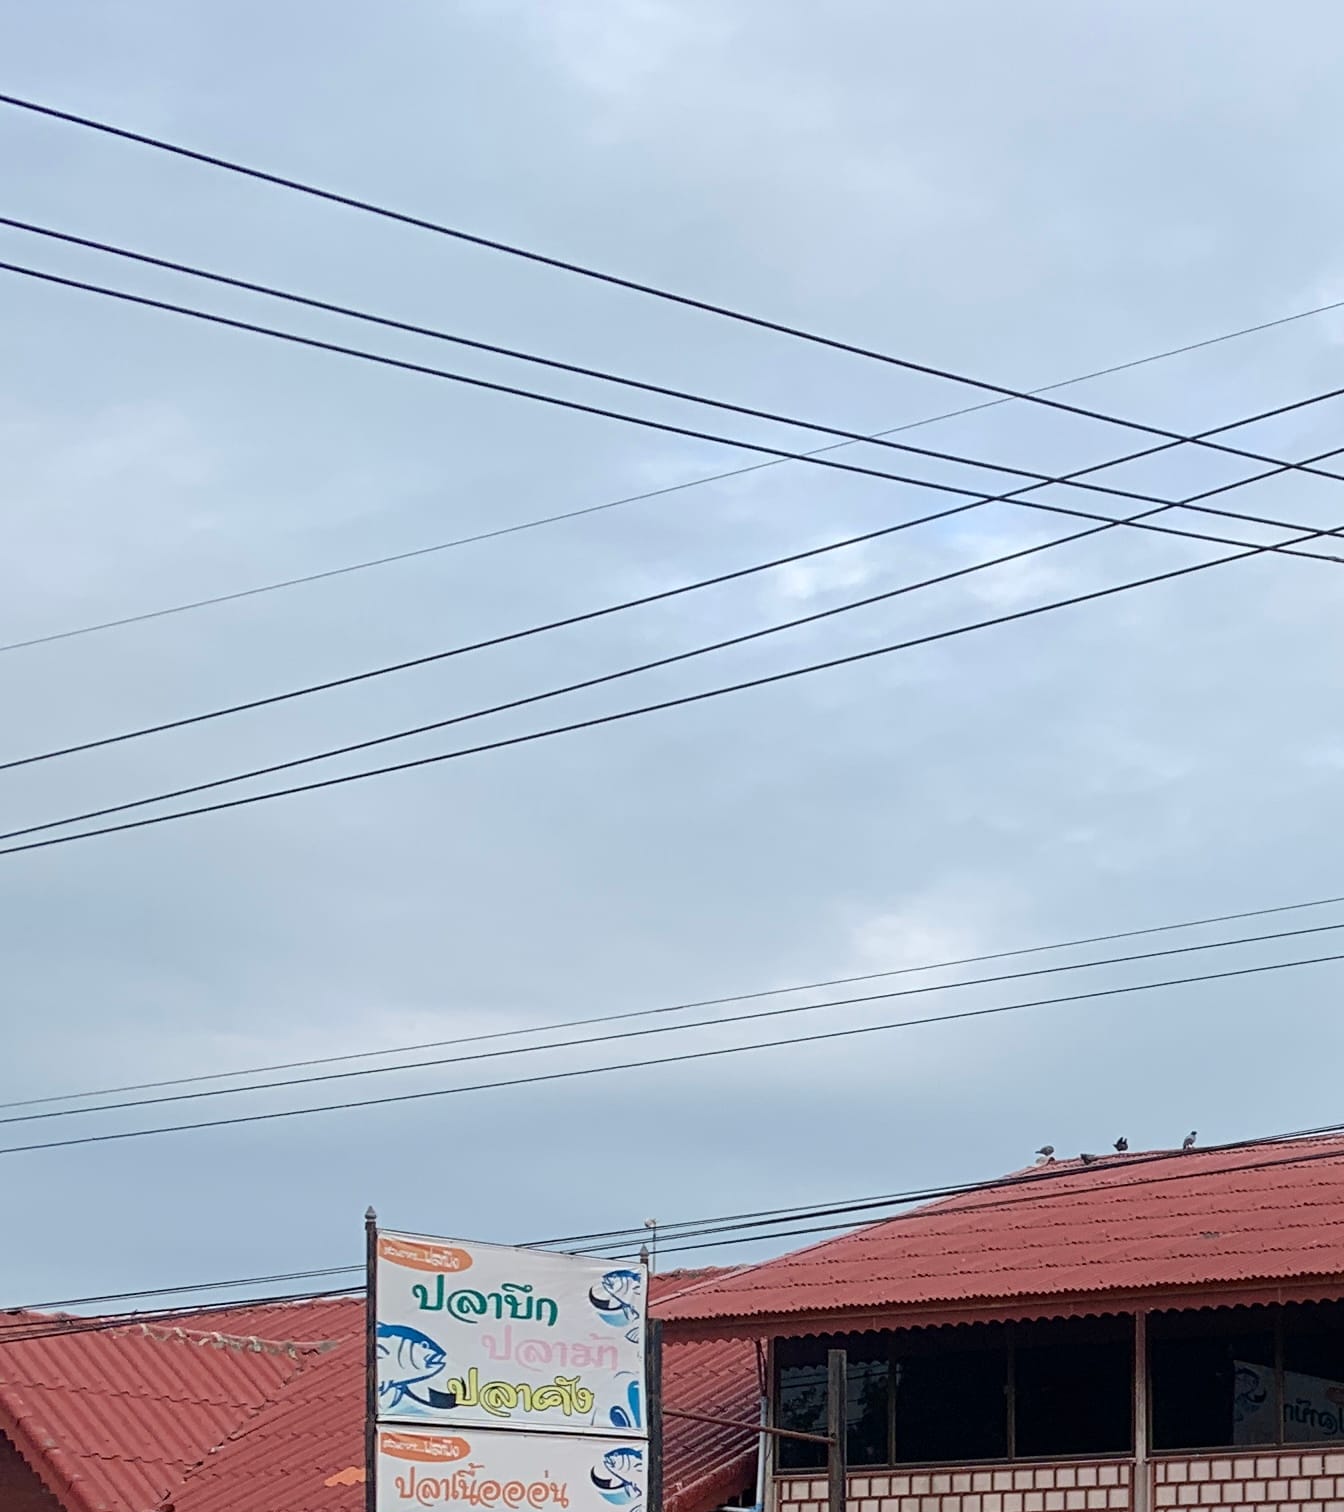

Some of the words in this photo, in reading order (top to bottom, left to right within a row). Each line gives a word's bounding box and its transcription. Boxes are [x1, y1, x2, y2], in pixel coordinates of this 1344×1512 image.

[412, 1274, 559, 1327] ปลาบึก
[447, 1367, 595, 1418] ปลาคัง
[395, 1462, 570, 1510] ปลาเนื้ออ่อน
